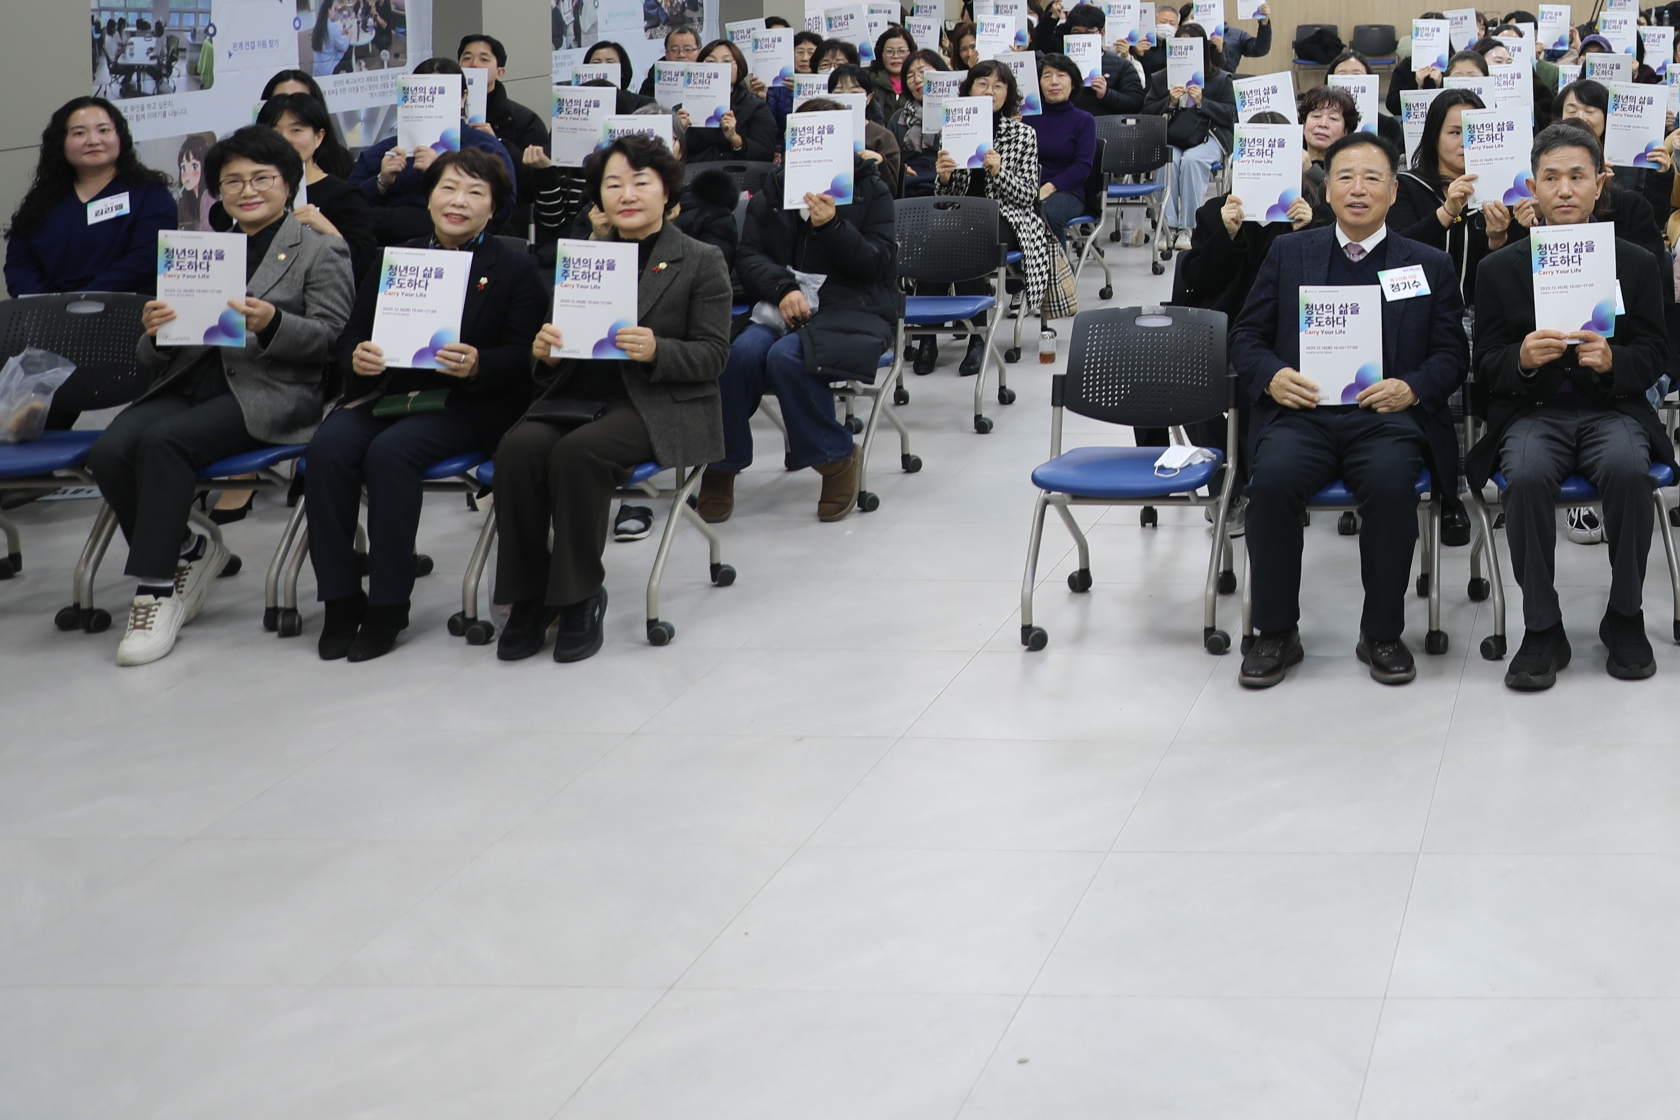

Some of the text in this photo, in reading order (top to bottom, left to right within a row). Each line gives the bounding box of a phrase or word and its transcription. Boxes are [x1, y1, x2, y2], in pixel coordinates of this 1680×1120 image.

[402, 86, 446, 95] 청년의 삶을
[401, 95, 435, 104] 주도하다
[790, 124, 834, 137] 청년의 삶을
[1466, 121, 1515, 135] 청년의 삶을
[790, 135, 824, 147] 주도하다
[1238, 137, 1286, 148] 청년의 삶을
[1467, 132, 1504, 145] 주도하다
[1237, 147, 1274, 159] 주도하다
[163, 248, 225, 261] 청년의 삶을
[1536, 240, 1595, 256] 청년의 삶을
[163, 260, 211, 273] 주도하다
[561, 256, 616, 272] 청년의 삶을
[1537, 253, 1583, 269] 주도하다
[386, 264, 445, 280] 청년의 삶을
[560, 269, 602, 283] 주도하다
[384, 277, 430, 292] 주도하다
[1390, 280, 1421, 292] 정기수
[1304, 303, 1359, 316] 청년의 삶을
[1304, 315, 1347, 329] 주도하다
